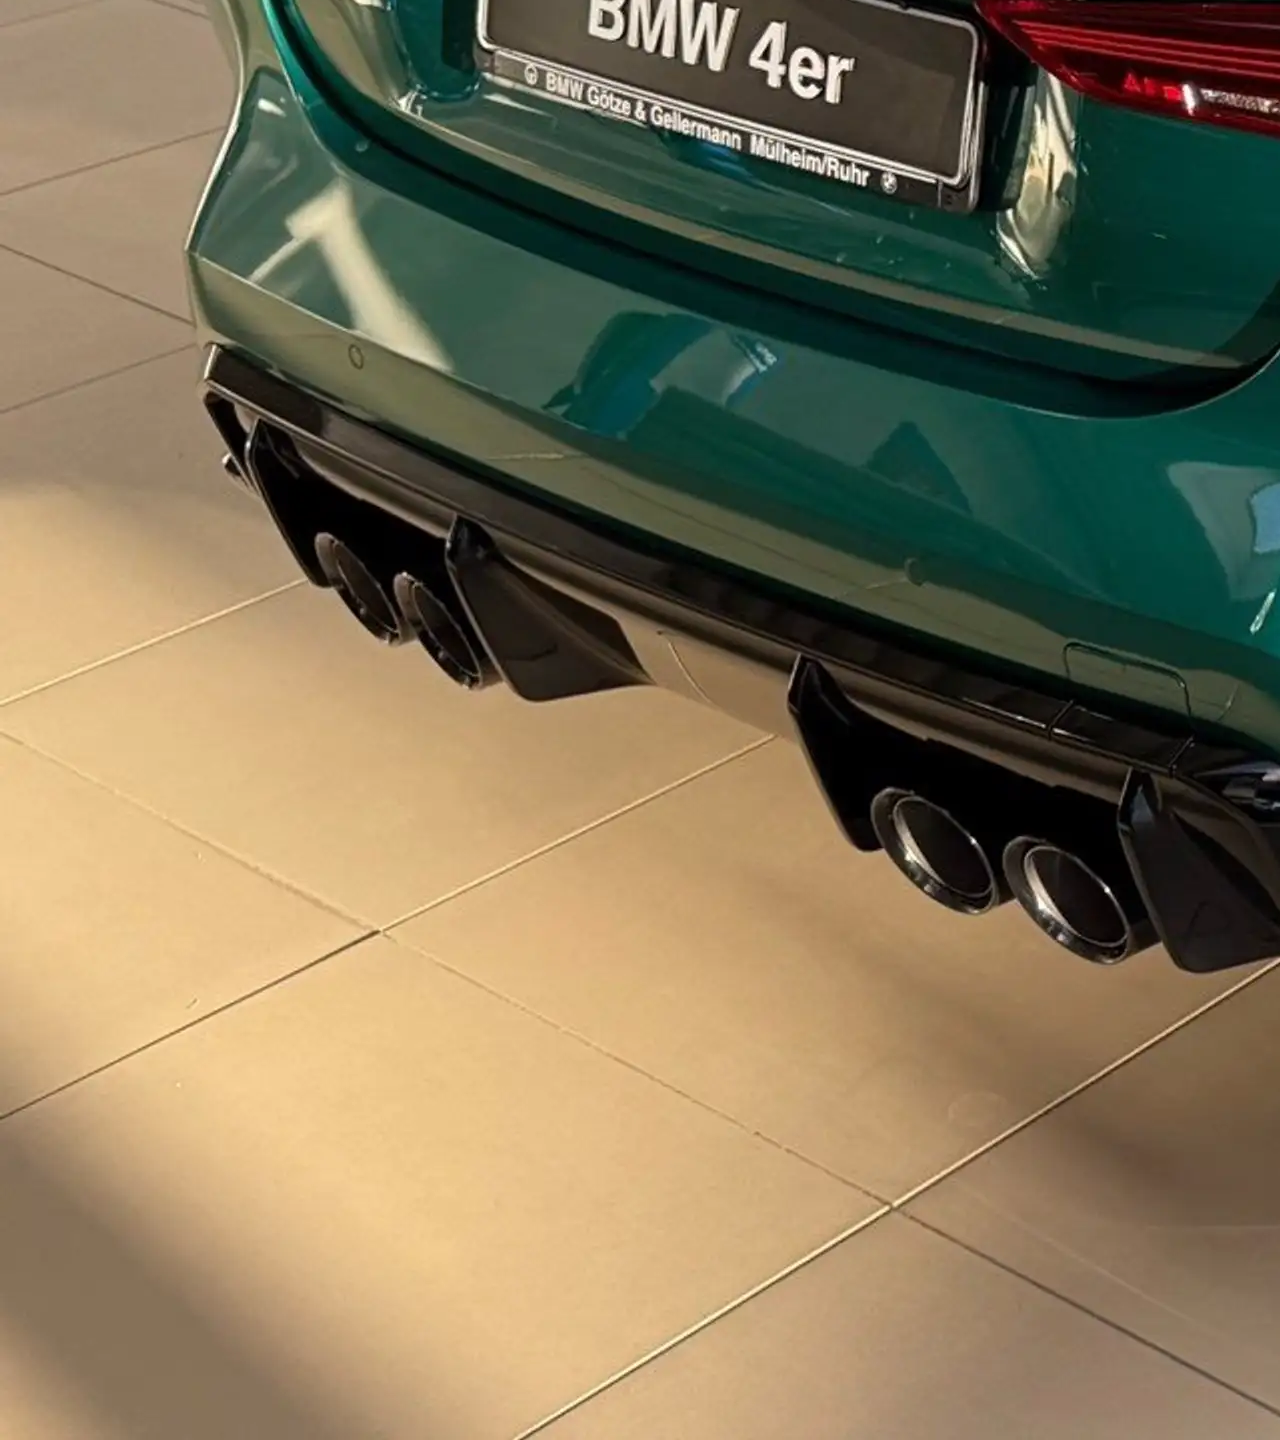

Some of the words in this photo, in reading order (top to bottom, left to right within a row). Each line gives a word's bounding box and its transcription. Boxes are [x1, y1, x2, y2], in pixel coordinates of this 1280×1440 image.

[748, 20, 856, 104] 4er
[545, 70, 584, 102] BMW
[587, 83, 631, 116] Götze
[634, 102, 647, 122] &
[650, 105, 743, 152] Gellermann
[750, 134, 871, 188] Mülheim/Ruhr
